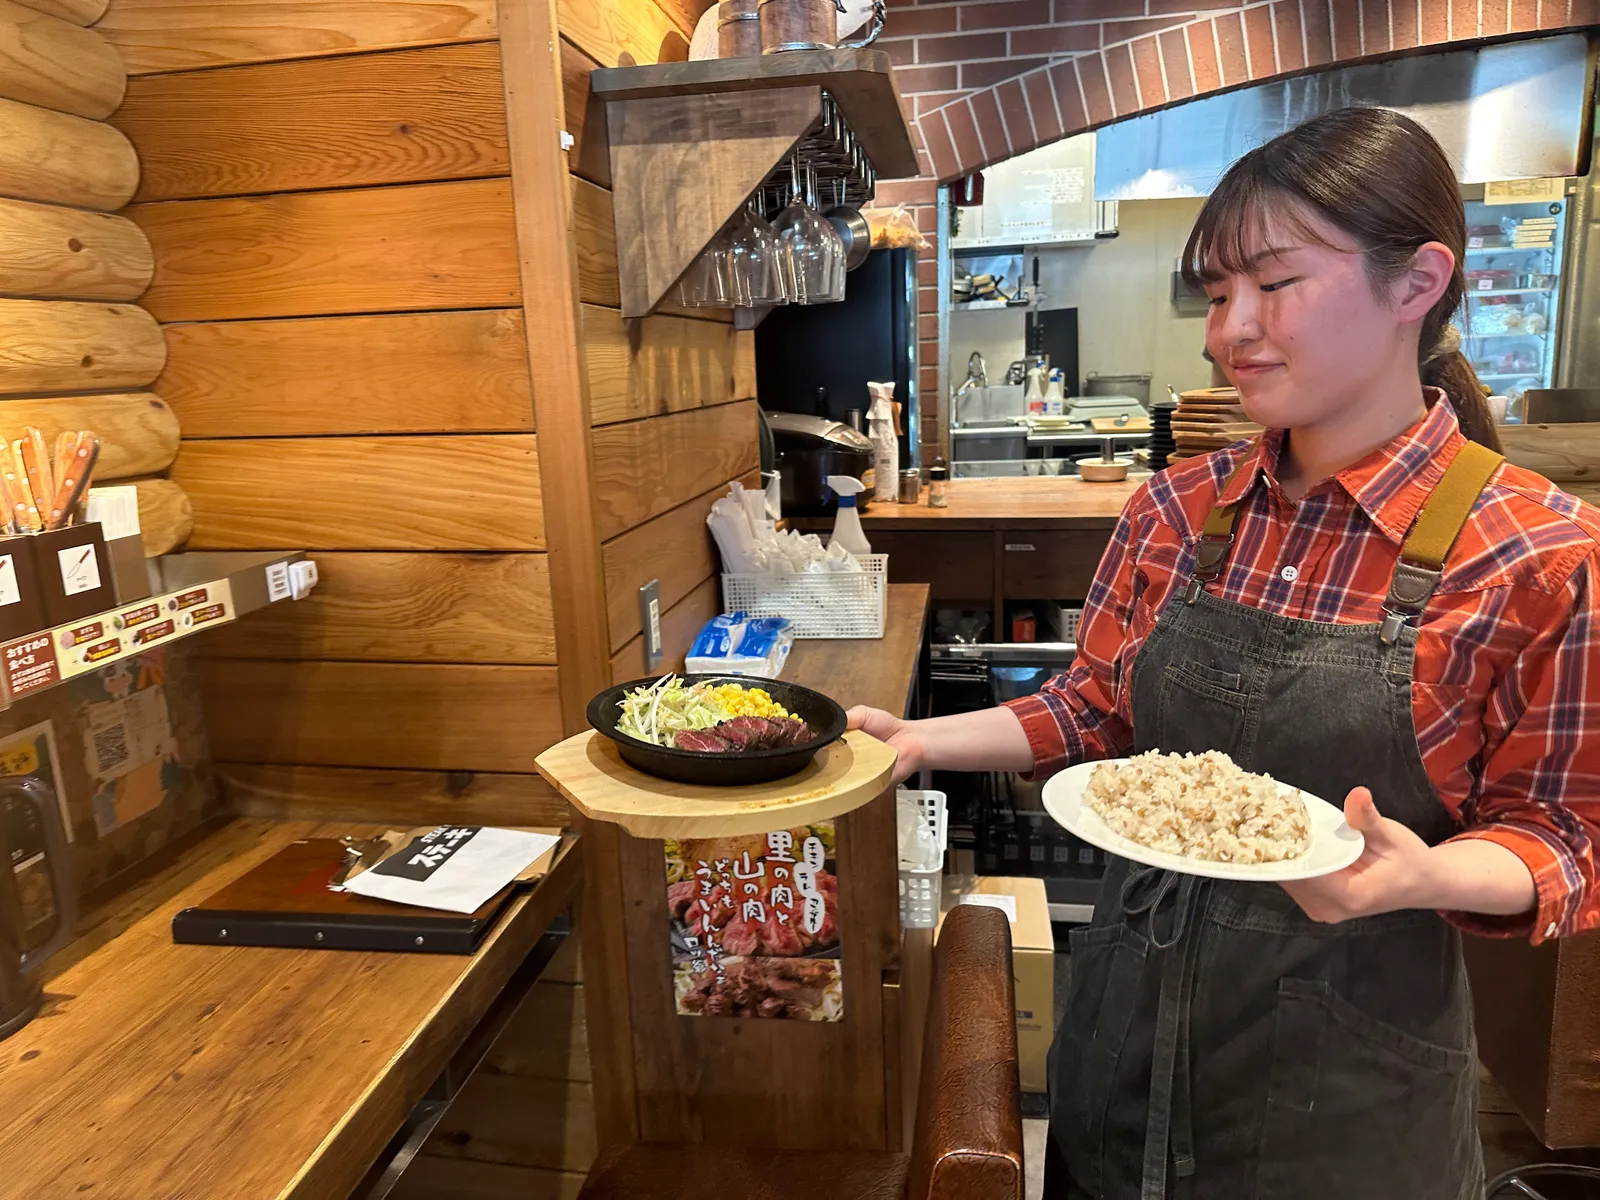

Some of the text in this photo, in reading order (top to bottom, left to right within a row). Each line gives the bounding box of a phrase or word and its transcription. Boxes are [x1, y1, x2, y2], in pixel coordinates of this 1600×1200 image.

[6, 637, 49, 659] おすすめの
[407, 828, 473, 868] ステーキ
[714, 858, 735, 909] どっちも
[733, 851, 766, 923] 山の肉
[765, 830, 796, 926] 里の肉と
